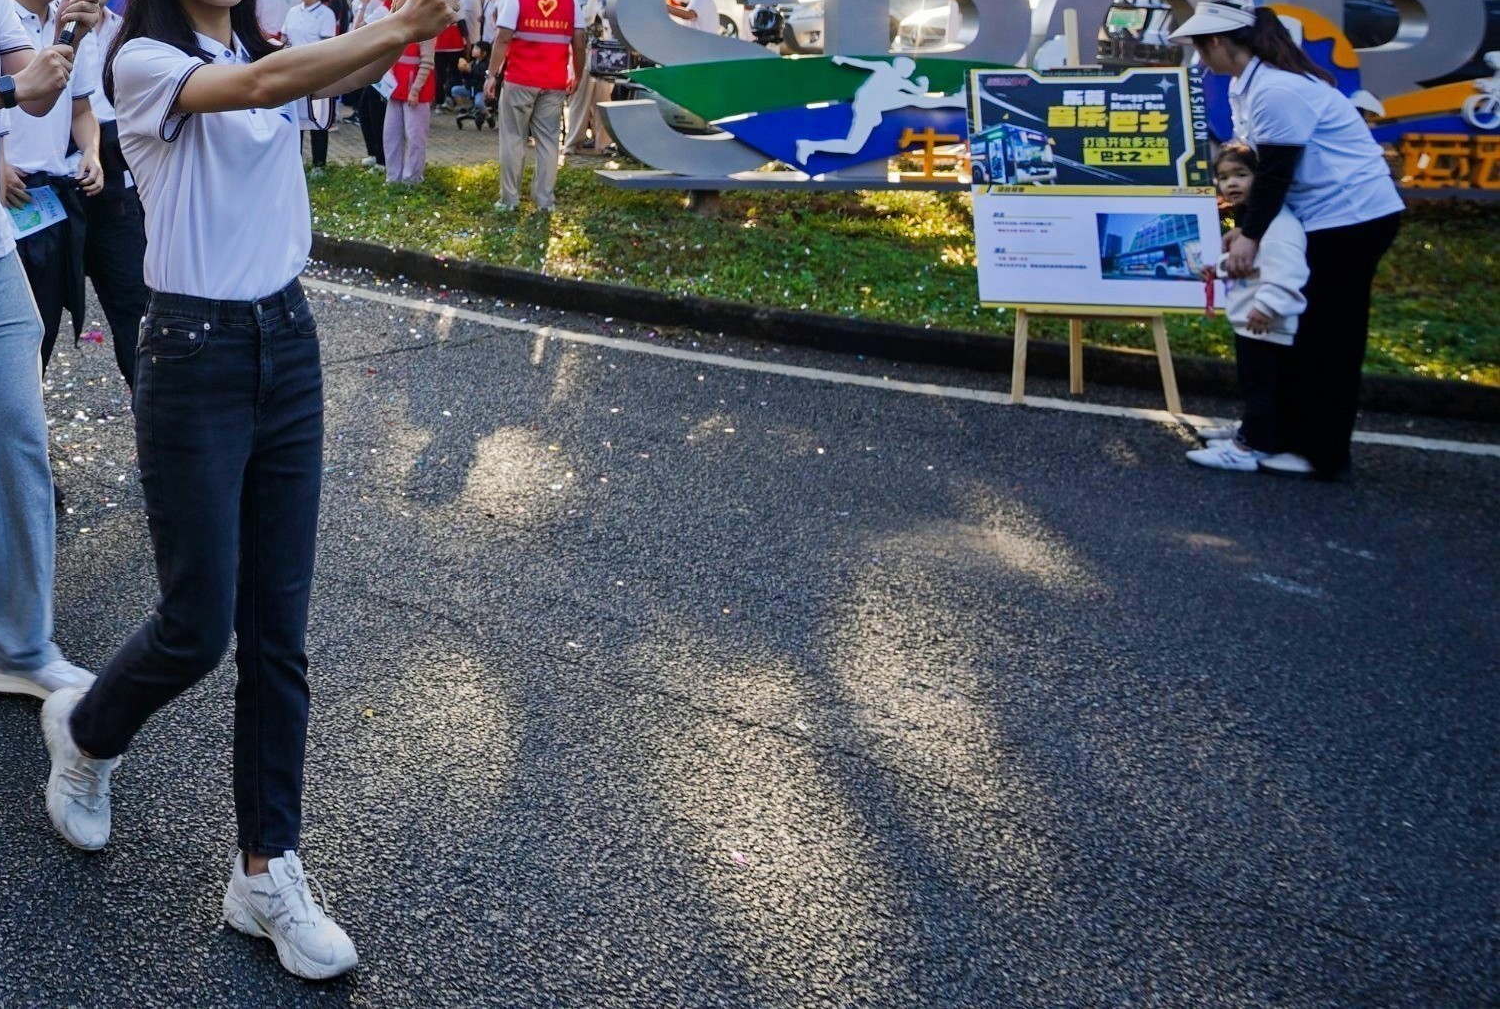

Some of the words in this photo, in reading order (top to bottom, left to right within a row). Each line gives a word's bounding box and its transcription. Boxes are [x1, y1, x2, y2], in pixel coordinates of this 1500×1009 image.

[1110, 102, 1143, 110] Music
[1189, 77, 1208, 140] FASHION
[1084, 136, 1169, 148] 打造开放多元的
